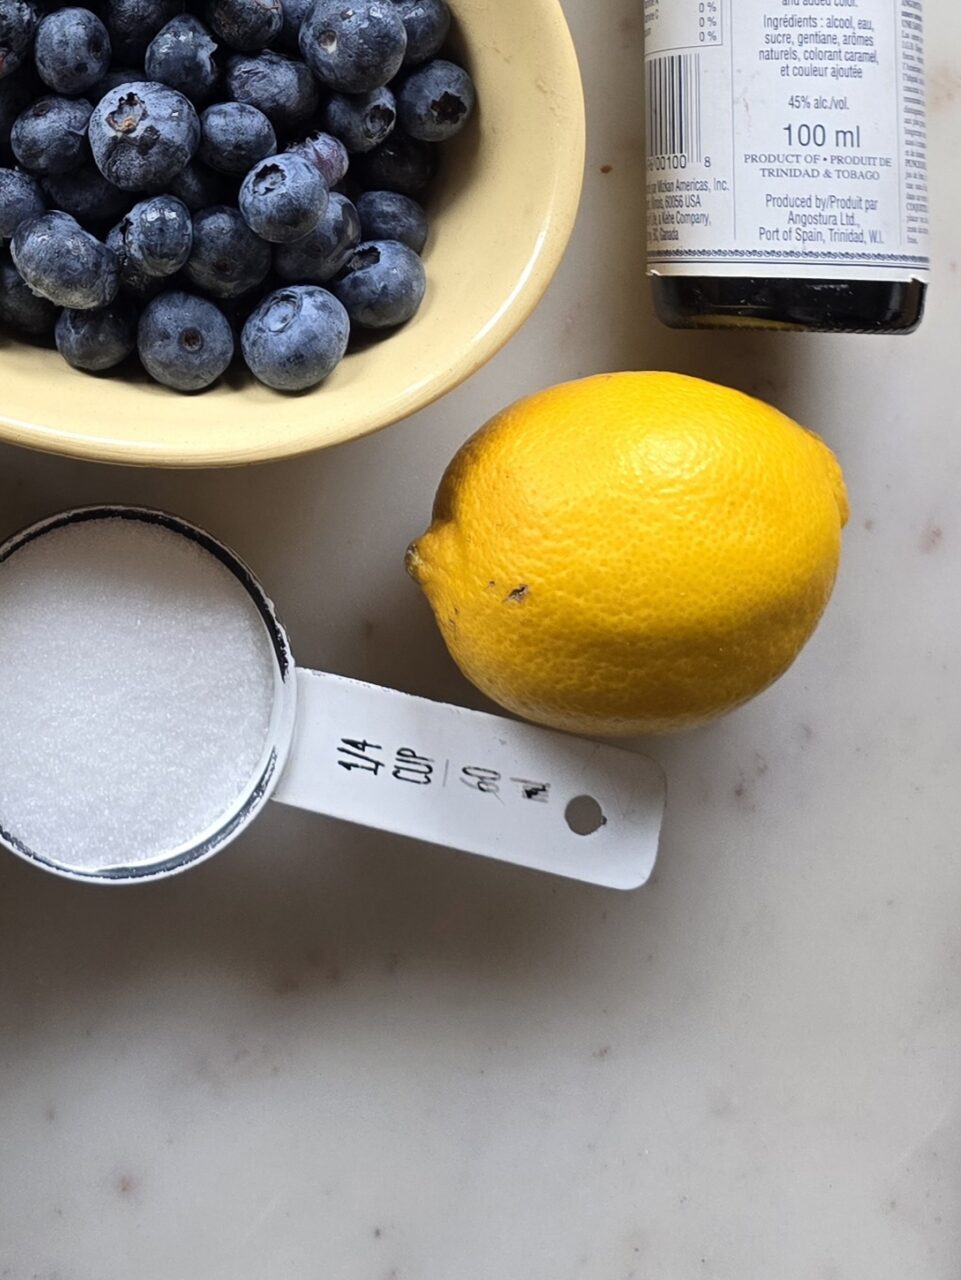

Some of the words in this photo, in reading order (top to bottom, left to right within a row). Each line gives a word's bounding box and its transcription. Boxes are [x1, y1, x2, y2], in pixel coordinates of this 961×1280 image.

[763, 14, 817, 30] Ingrédients
[826, 15, 855, 30] alcool,
[765, 33, 795, 46] sucre,
[797, 31, 840, 47] gentiane,
[842, 32, 874, 46] arômes
[759, 47, 801, 61] naturels,
[803, 47, 841, 61] colorant
[780, 65, 789, 77] et
[792, 64, 828, 77] couleur
[830, 65, 863, 80] ajoutée
[788, 95, 811, 109] 45%
[783, 123, 826, 147] 100
[835, 125, 860, 148] ml
[704, 156, 711, 168] 8
[744, 153, 801, 163] PRODUCT
[804, 154, 821, 163] OF
[830, 155, 878, 166] PRODUIT
[879, 157, 892, 167] DE
[760, 168, 820, 178] TRINIDAD
[823, 169, 832, 178] &
[835, 170, 880, 180] TOBAGO
[713, 177, 729, 191] Inc.
[685, 194, 701, 208] USA
[765, 193, 812, 208] Produced
[815, 194, 863, 211] by/Produit
[865, 198, 878, 212] par
[788, 210, 837, 227] Angostura
[759, 227, 780, 241] Port
[782, 227, 792, 241] of
[795, 227, 825, 244] Spain,
[828, 228, 866, 245] Trinidad,
[336, 738, 385, 776] 1/4
[392, 746, 436, 785] CUP
